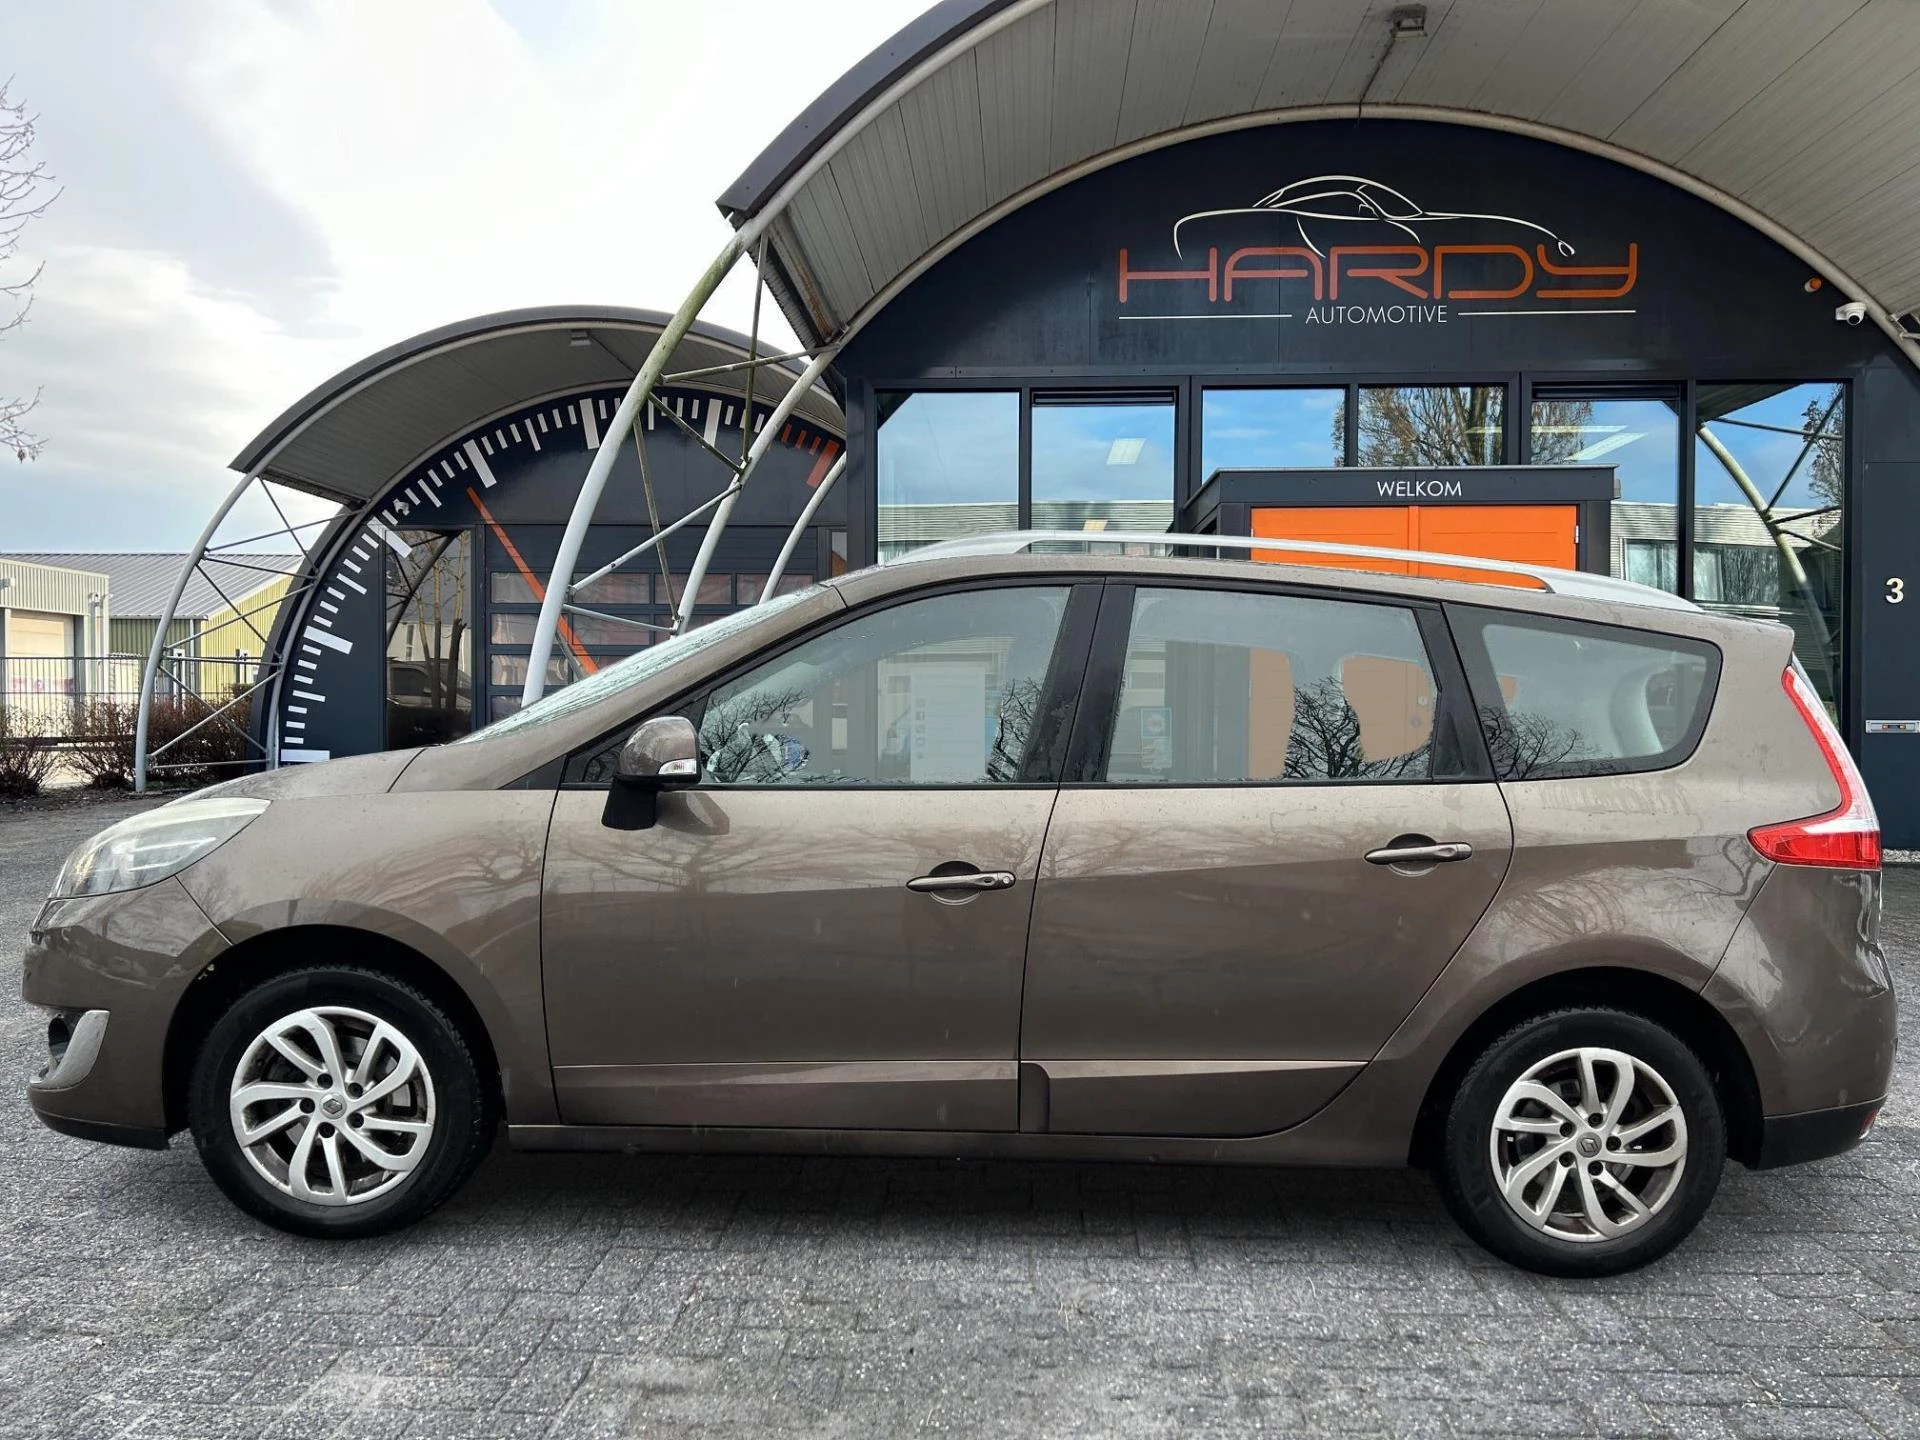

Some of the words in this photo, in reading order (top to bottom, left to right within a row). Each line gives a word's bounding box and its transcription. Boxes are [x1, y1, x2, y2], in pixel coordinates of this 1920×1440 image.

[1119, 243, 1638, 302] HARDY
[1305, 305, 1447, 325] AUTOMOTIVE
[1376, 480, 1462, 497] WELKOM
[1886, 577, 1904, 604] 3
